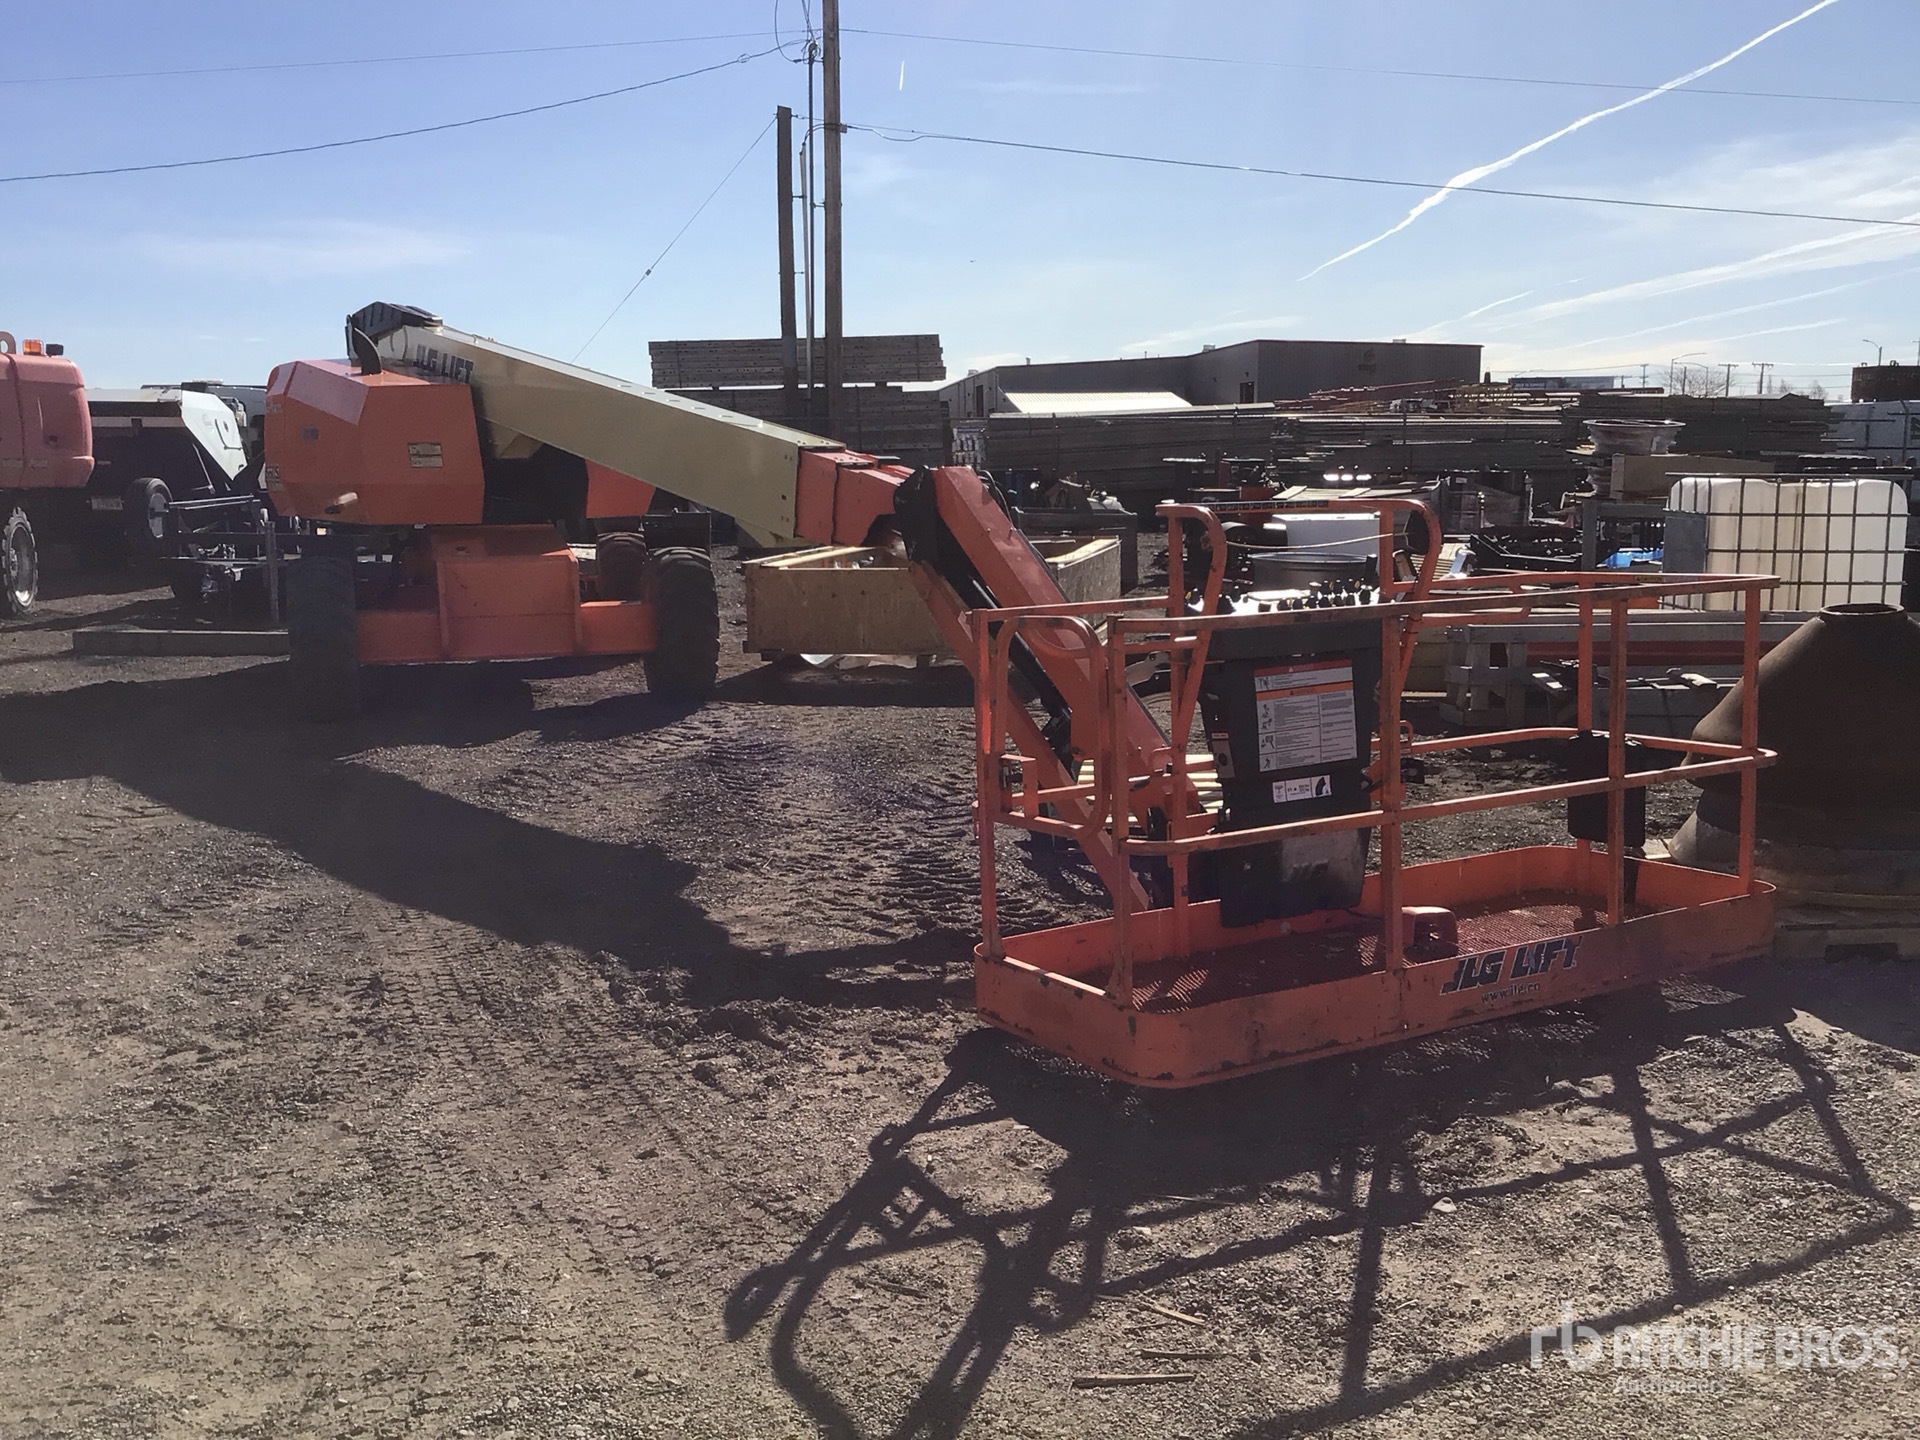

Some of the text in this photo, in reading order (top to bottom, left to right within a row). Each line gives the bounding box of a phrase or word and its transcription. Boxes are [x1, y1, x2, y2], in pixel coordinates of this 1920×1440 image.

[413, 344, 474, 383] JLG LIFT
[1440, 937, 1582, 995] JLG LIFT
